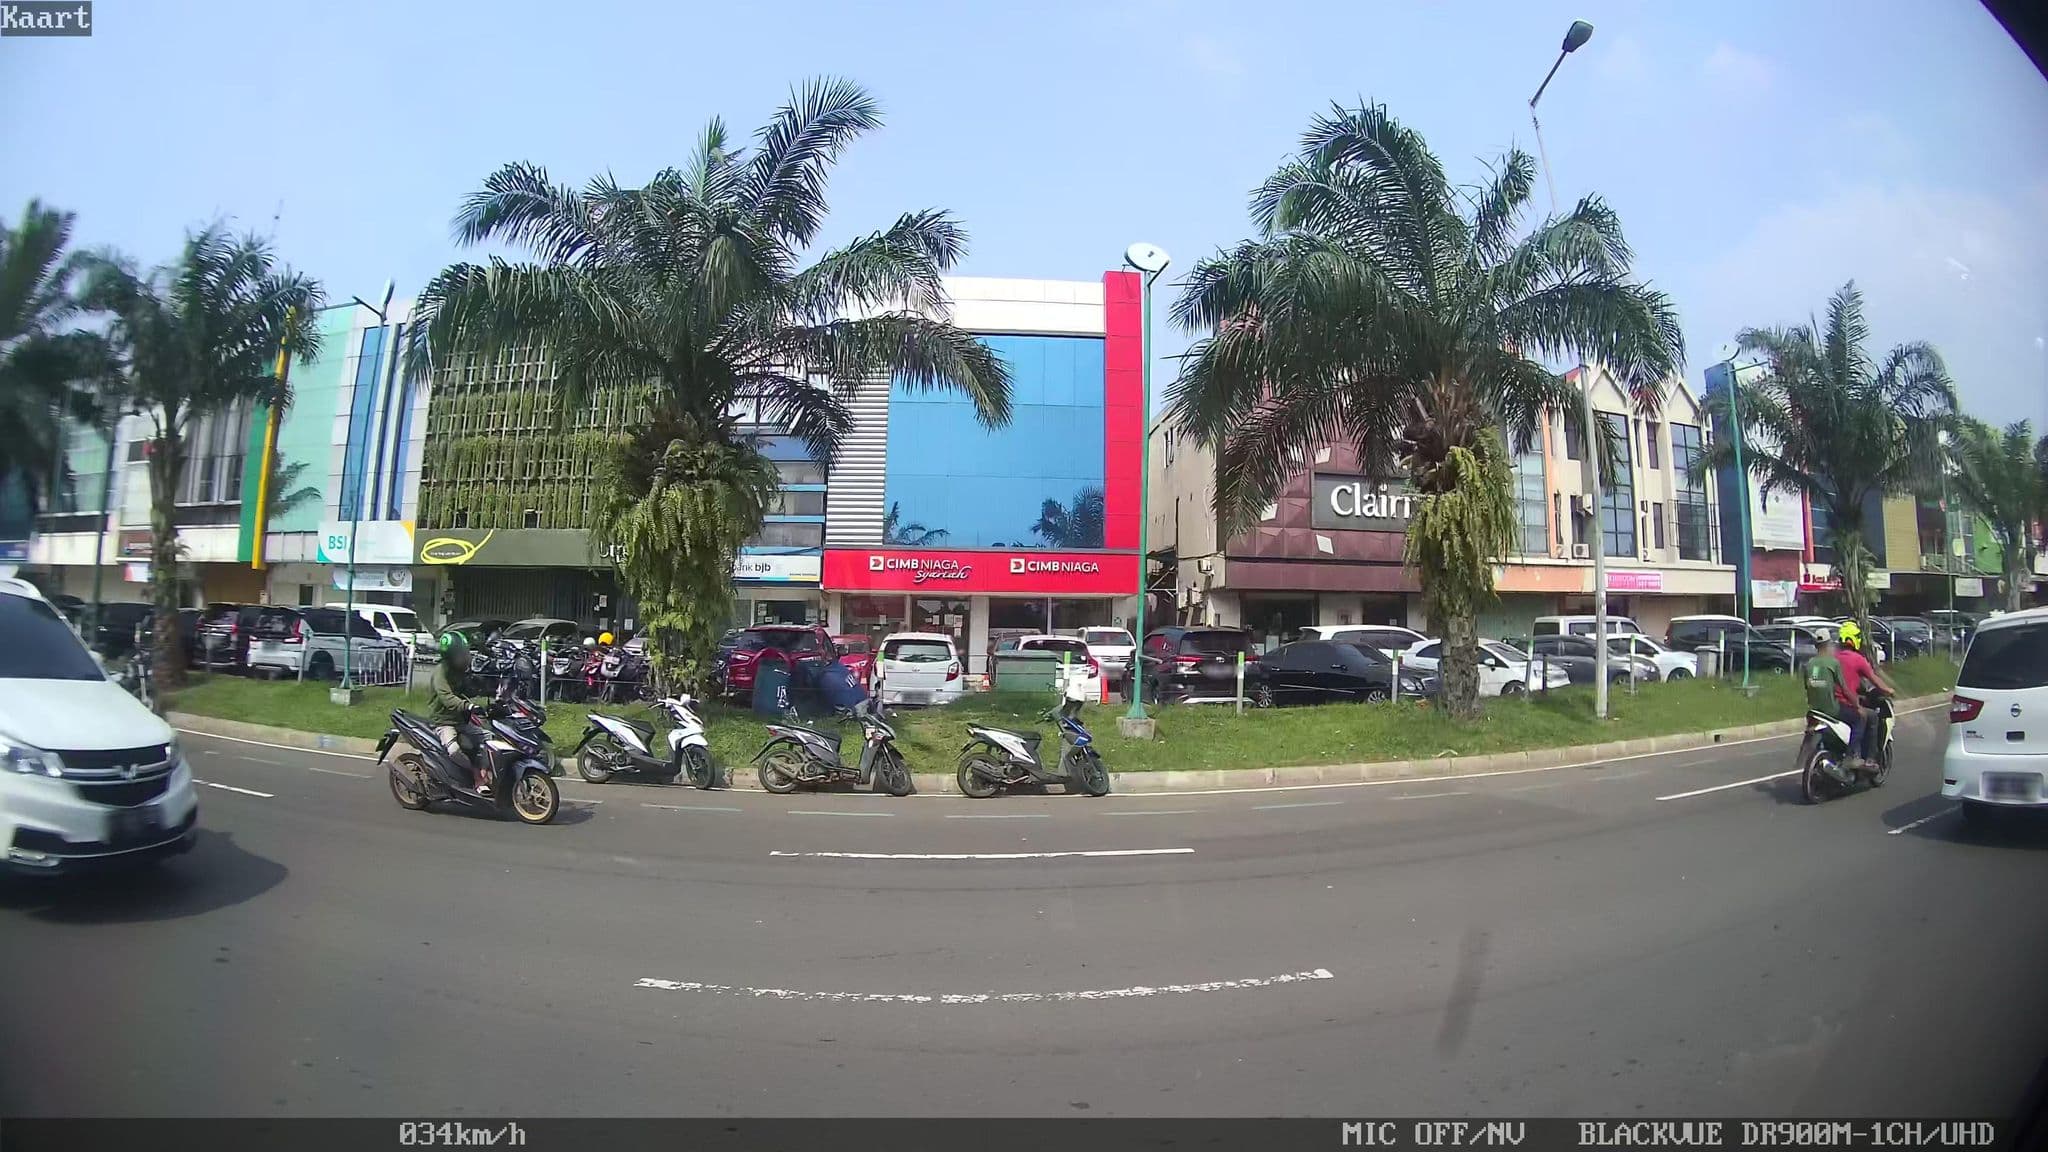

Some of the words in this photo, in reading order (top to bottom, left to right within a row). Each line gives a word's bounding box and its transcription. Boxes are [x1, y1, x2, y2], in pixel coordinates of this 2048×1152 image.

[328, 535, 347, 550] BSI
[754, 562, 771, 574] bjb
[886, 558, 919, 569] CIMB
[921, 559, 959, 570] NIAGA
[1027, 560, 1060, 572] CIMB
[1061, 561, 1099, 573] NIAGA
